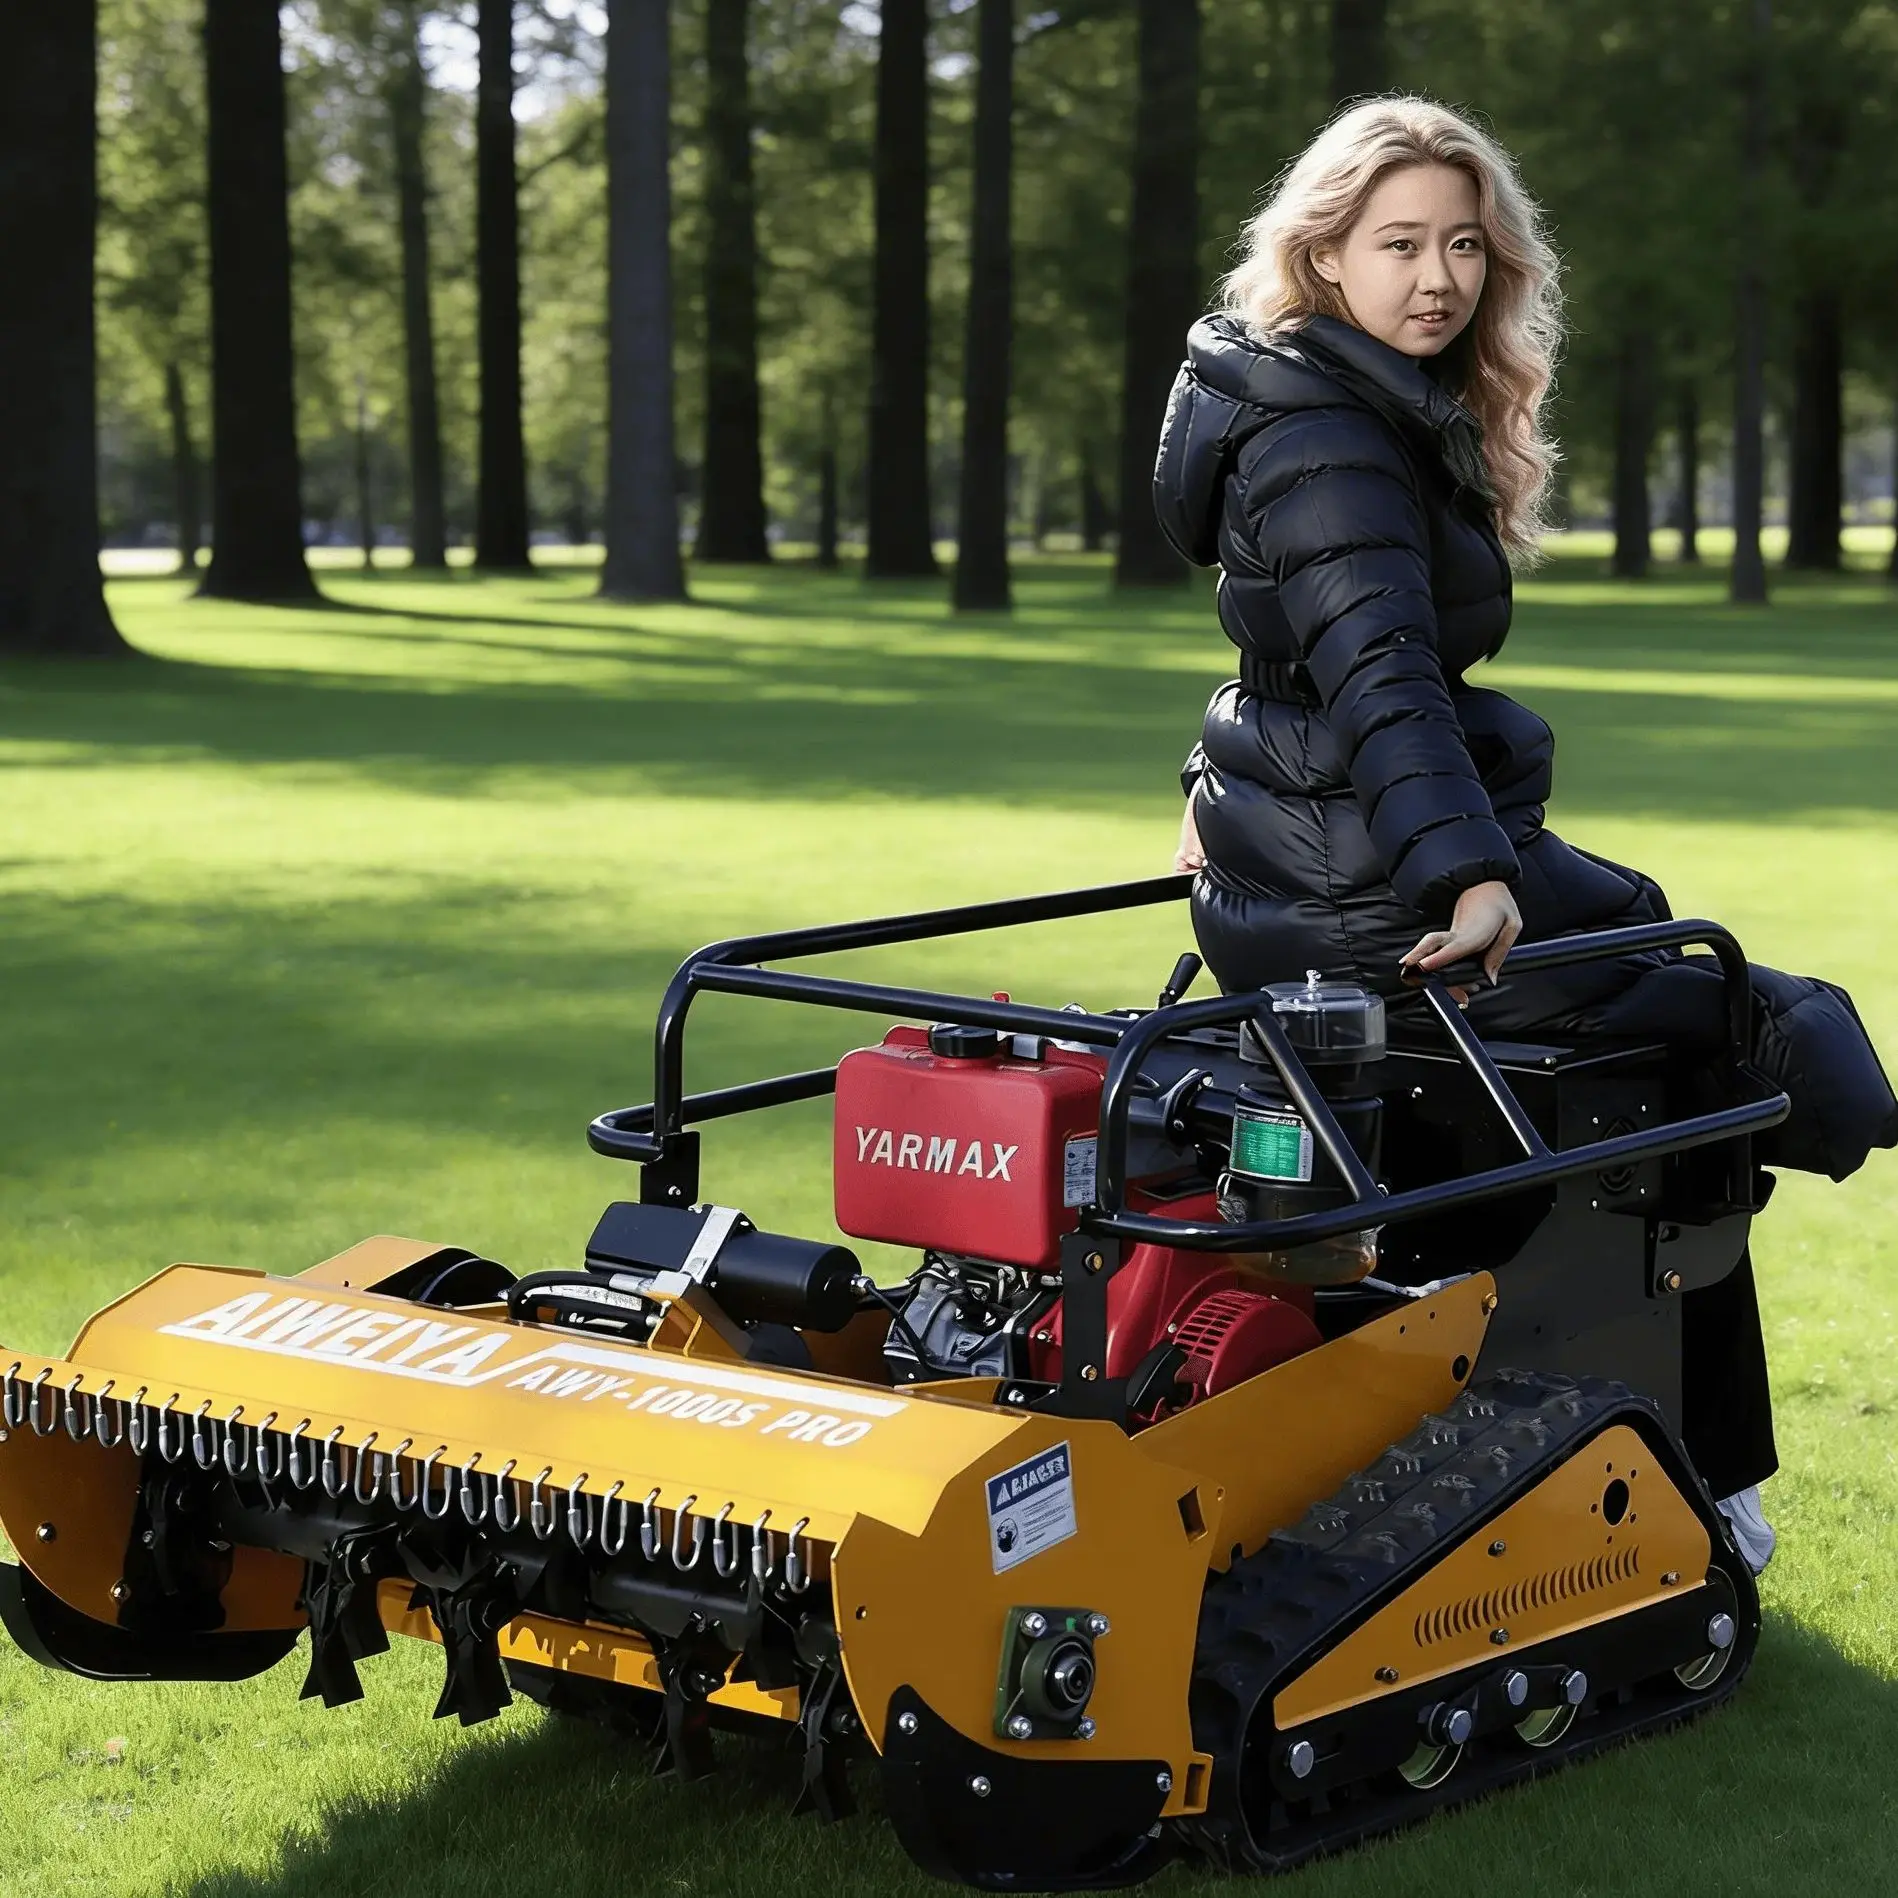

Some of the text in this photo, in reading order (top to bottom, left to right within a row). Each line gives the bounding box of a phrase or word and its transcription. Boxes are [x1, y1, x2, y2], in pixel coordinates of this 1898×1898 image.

[855, 1126, 1019, 1182] YARMAX
[176, 1291, 512, 1377] AIWEIYA
[505, 1365, 874, 1447] AWY-1000S PRO
